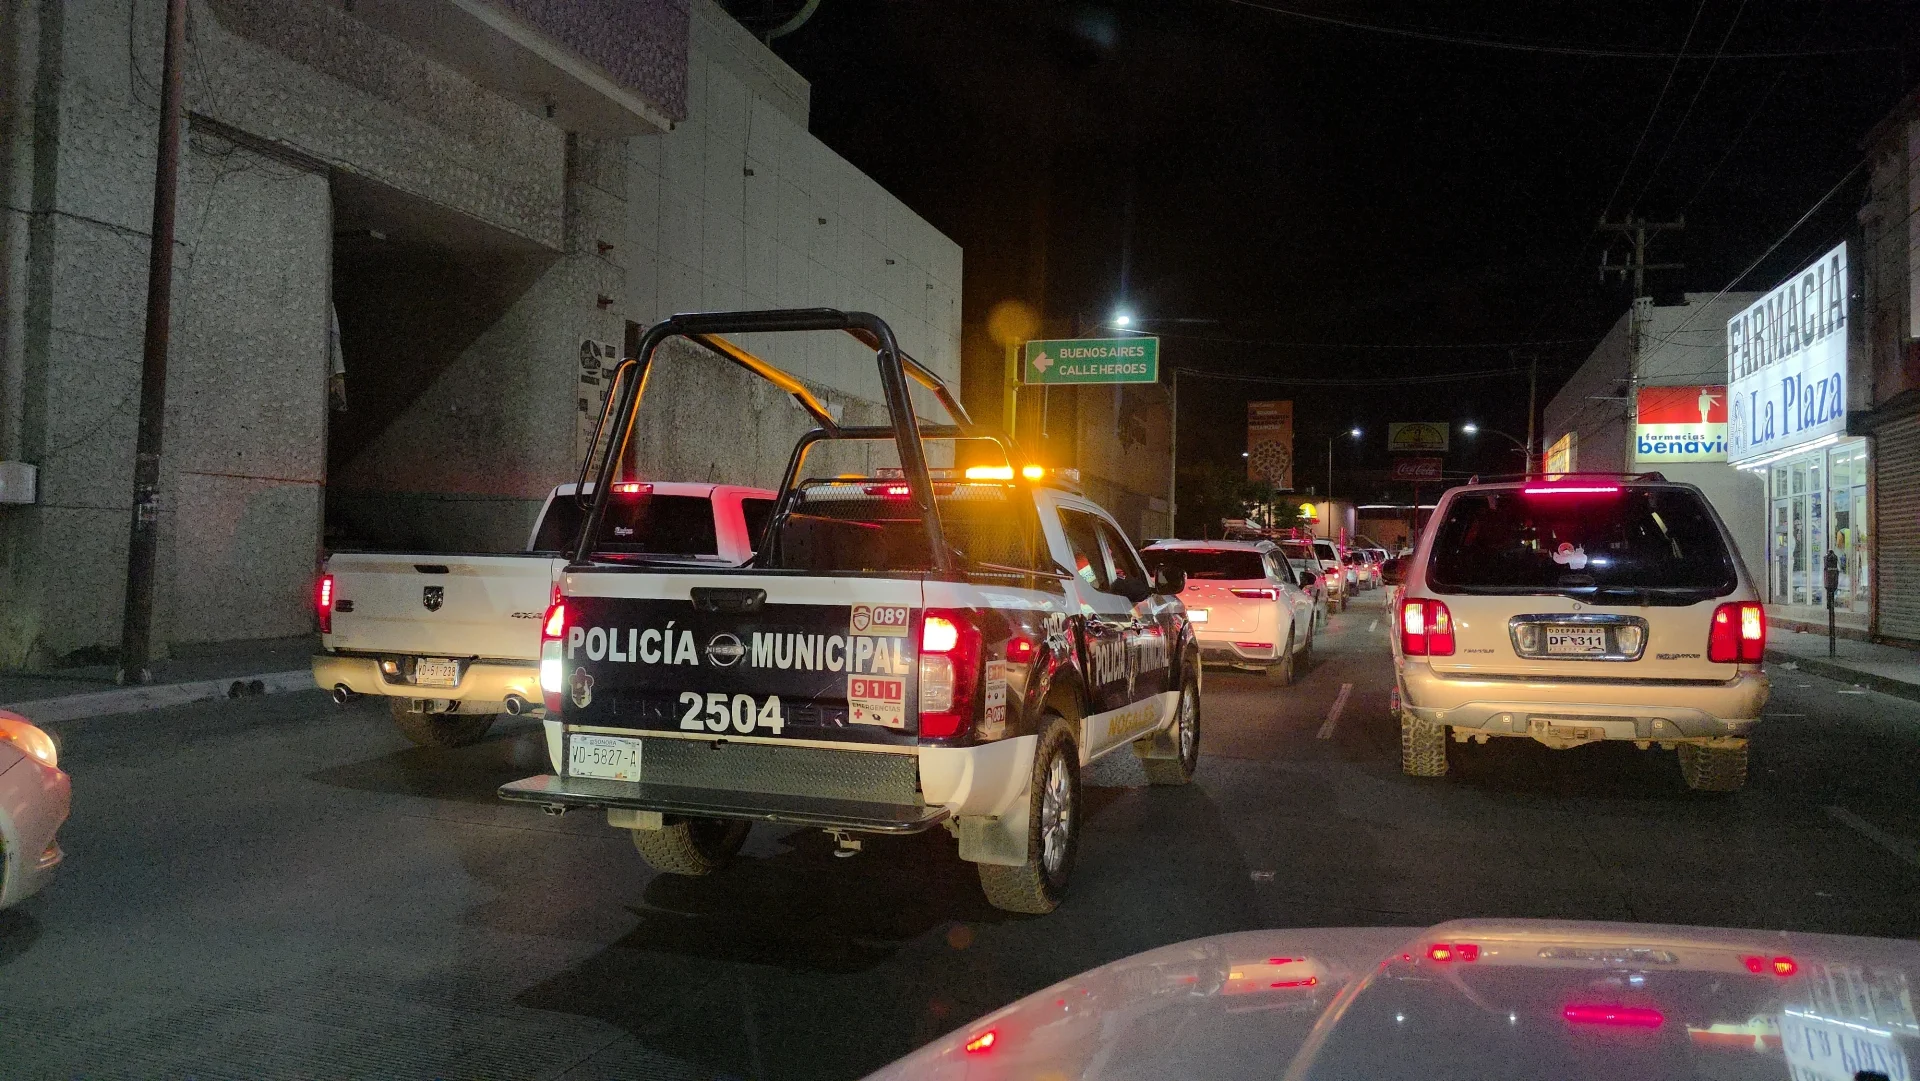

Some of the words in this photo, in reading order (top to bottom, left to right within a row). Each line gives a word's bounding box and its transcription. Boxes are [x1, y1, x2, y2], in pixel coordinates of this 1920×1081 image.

[1731, 254, 1844, 384] FARMACIA
[1060, 348, 1107, 359] BUENOS
[1109, 347, 1144, 357] AIRES
[1059, 365, 1098, 375] CALLE
[1099, 364, 1147, 375] HEROES
[1750, 390, 1775, 446] La
[1781, 372, 1844, 436] Plaza
[1637, 435, 1728, 454] benavi
[1645, 433, 1705, 441] farmacias
[873, 607, 906, 625] 089
[568, 621, 699, 666] POLICÍA
[751, 632, 909, 674] MUNICIPAL
[705, 646, 744, 655] NISSAN
[854, 682, 897, 698] 911
[680, 691, 785, 734] 2504
[852, 702, 901, 713] EMERGENCIAS
[572, 745, 637, 768] VD-5827-A
